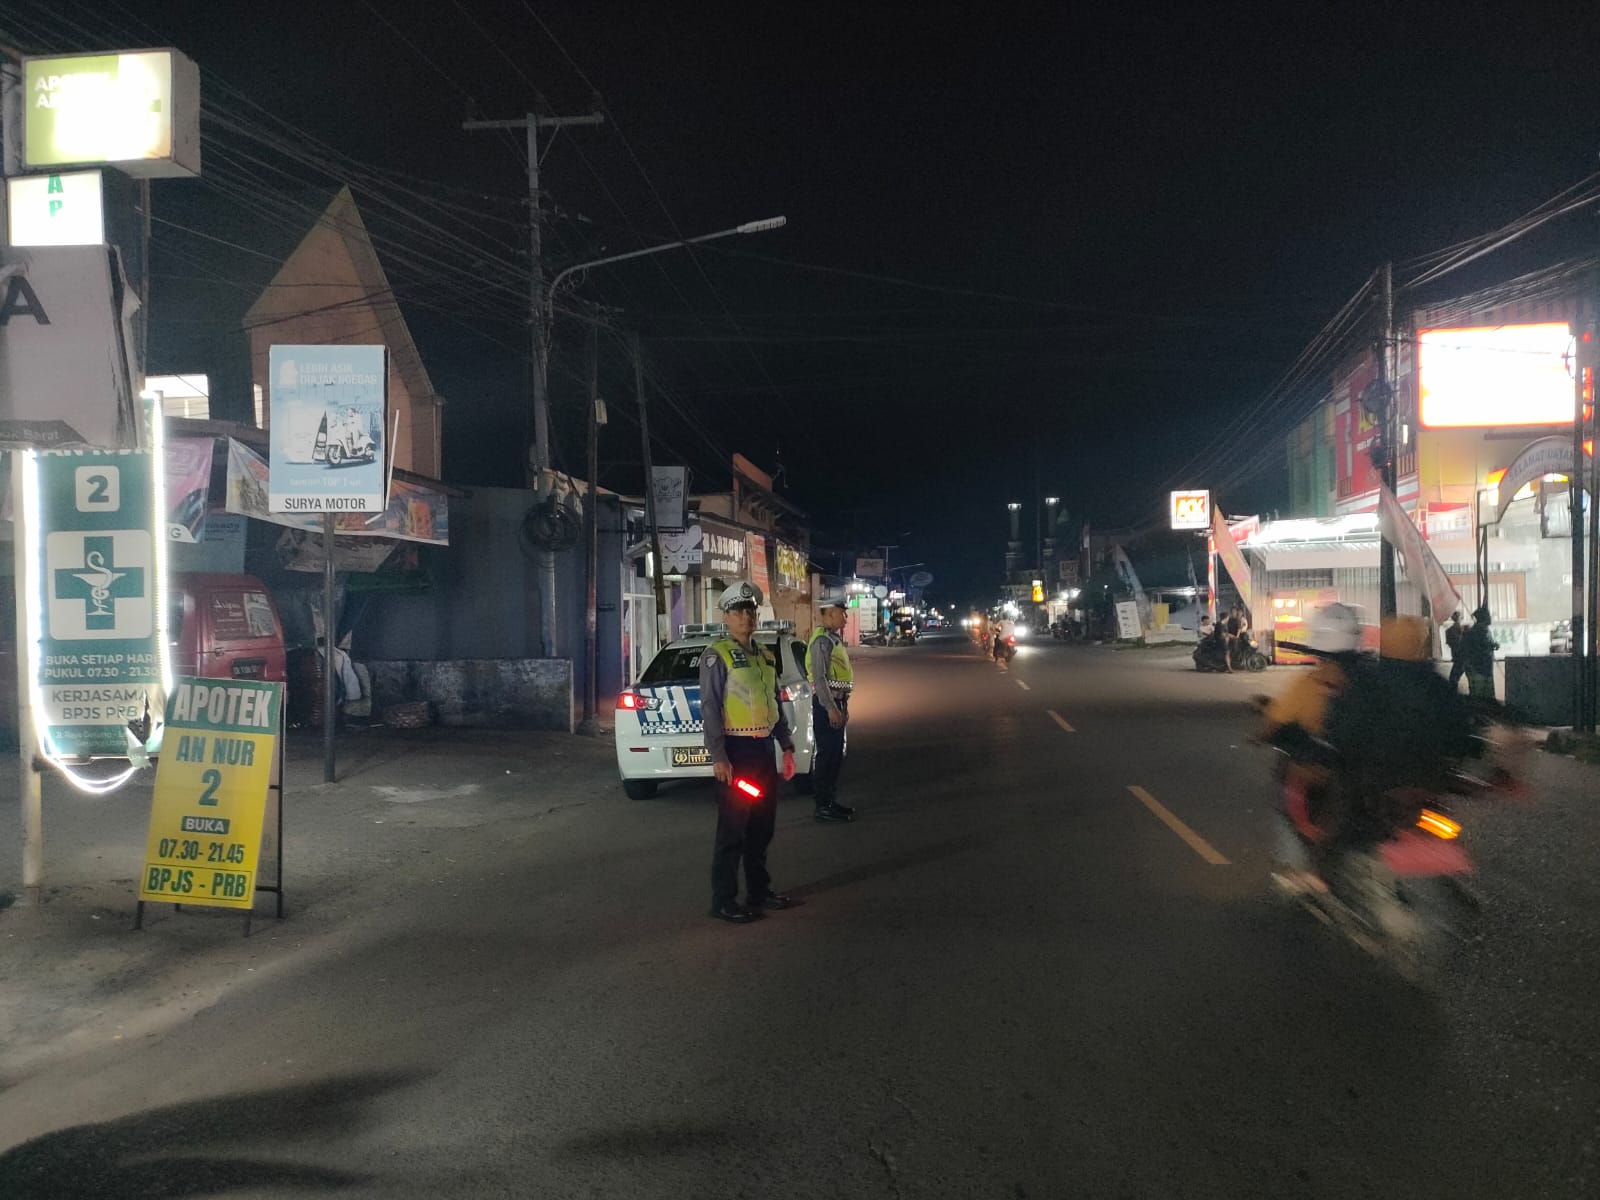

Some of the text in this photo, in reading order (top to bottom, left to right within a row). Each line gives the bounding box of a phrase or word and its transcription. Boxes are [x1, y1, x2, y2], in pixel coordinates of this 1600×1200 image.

[86, 474, 110, 503] 2
[284, 497, 366, 509] SURYA MOTOR
[46, 655, 79, 665] BUKA
[81, 654, 124, 665] SETIAP
[44, 667, 85, 678] PUKUL
[87, 667, 118, 677] 07.30
[62, 705, 138, 720] BPJS PRB
[172, 683, 273, 728] APOTEK
[176, 735, 256, 766] AN NUR
[198, 768, 222, 806] 2
[185, 818, 225, 833] BUKA
[208, 842, 246, 864] 21.45
[147, 867, 194, 893] BPJS
[211, 872, 247, 898] PRB
